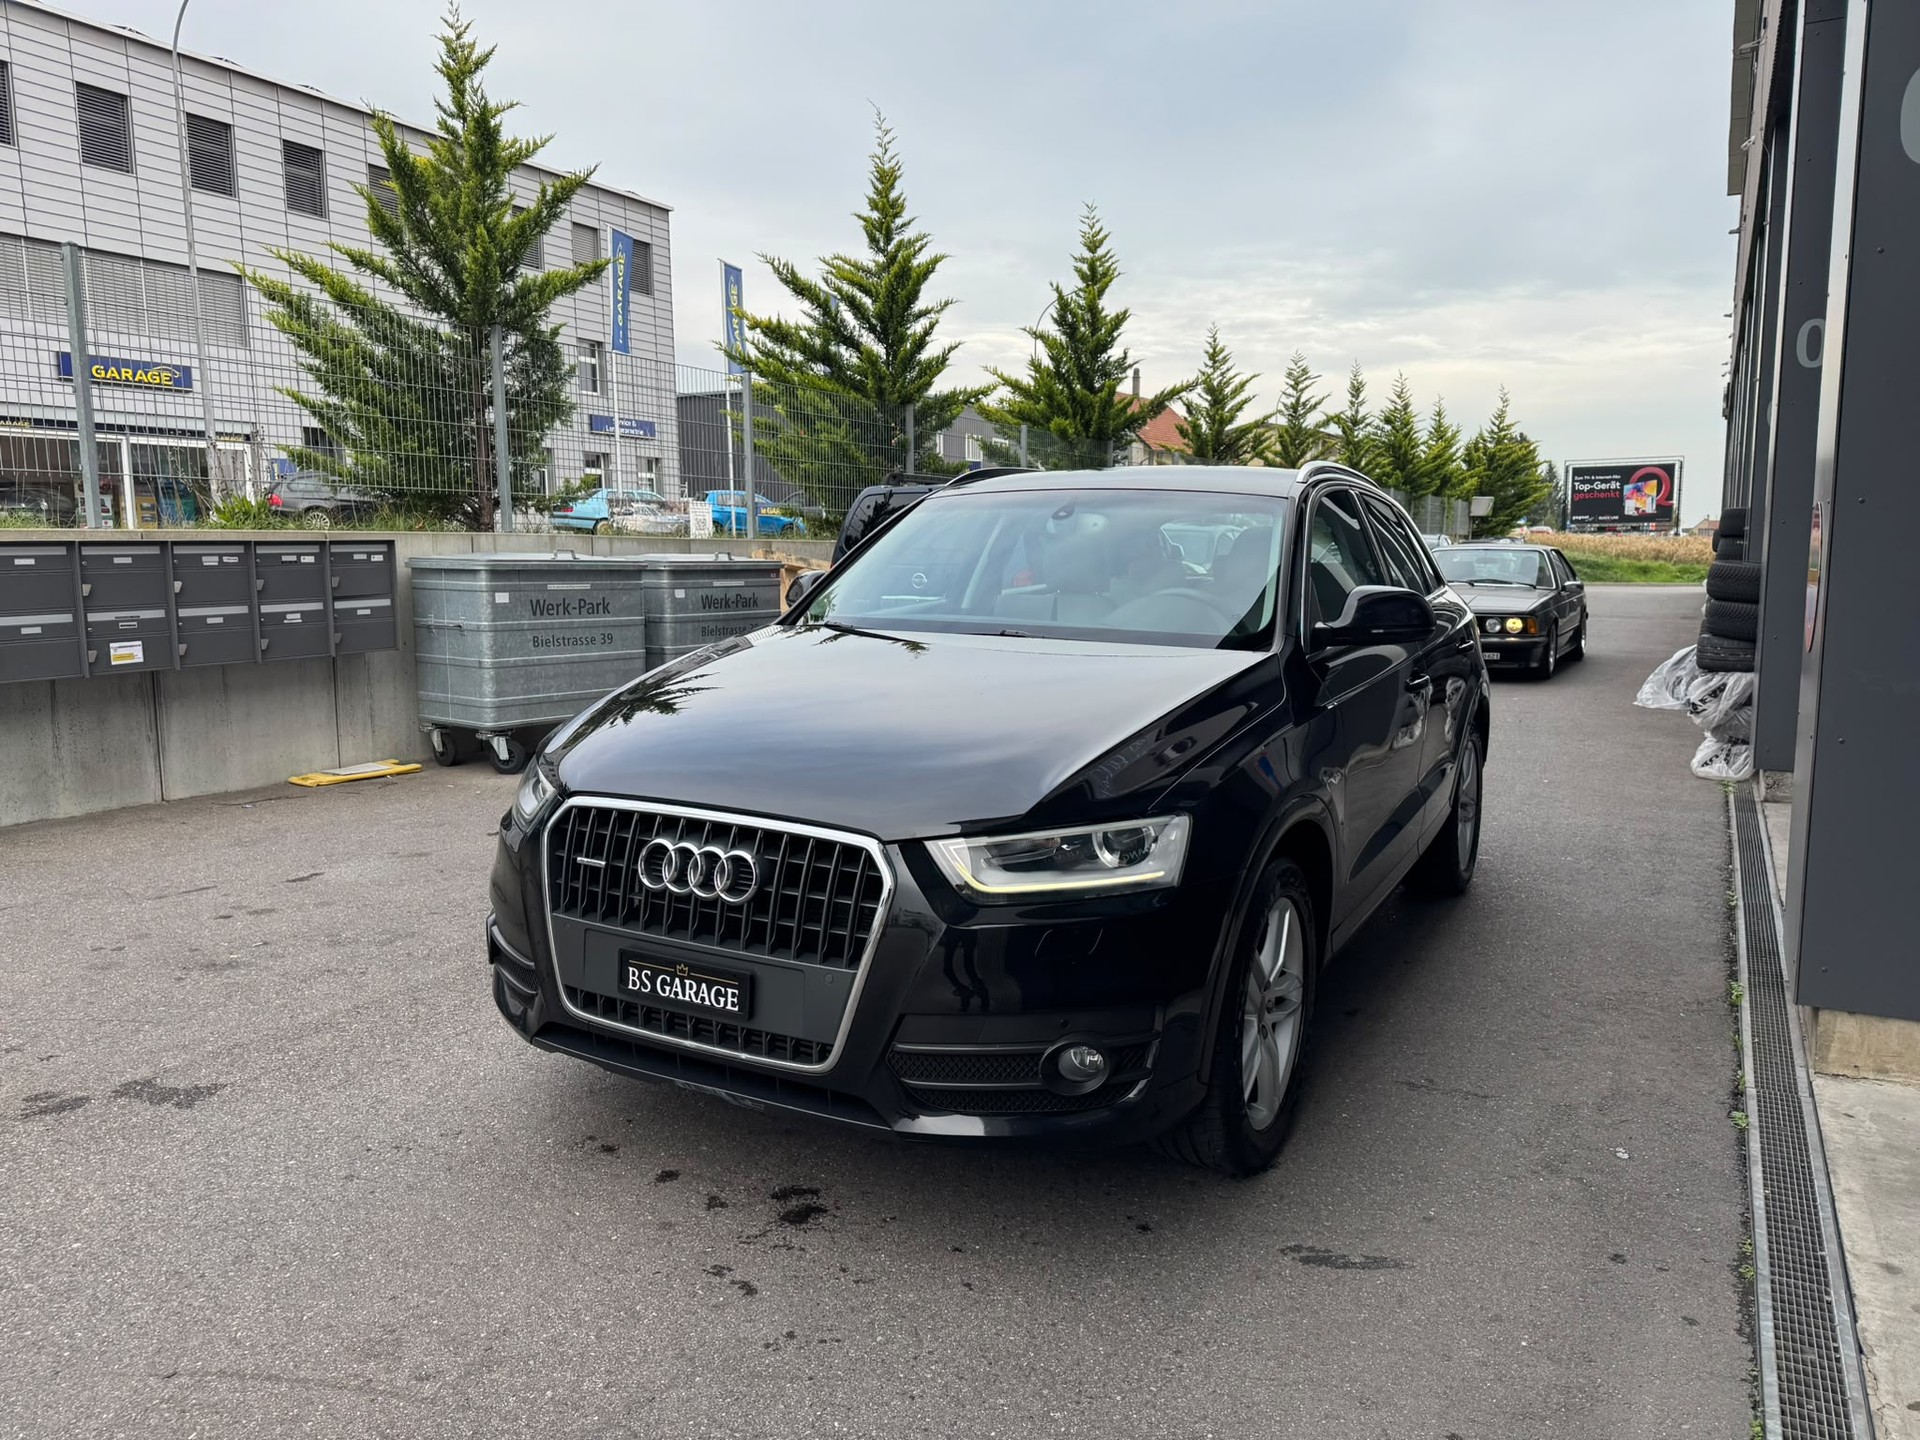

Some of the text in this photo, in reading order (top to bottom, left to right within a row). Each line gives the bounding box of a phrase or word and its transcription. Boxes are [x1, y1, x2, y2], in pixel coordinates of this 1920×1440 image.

[617, 252, 626, 327] GARAGE
[91, 364, 174, 386] GARAGE
[1573, 481, 1620, 492] Top-Gerät
[1573, 490, 1619, 501] geschenkt
[530, 597, 611, 616] Werk-Park
[701, 592, 758, 609] Werk-Park
[701, 625, 747, 637] Bielstrasse
[532, 633, 613, 648] Bielstrasse 39
[628, 967, 739, 1011] BS GARAGE
